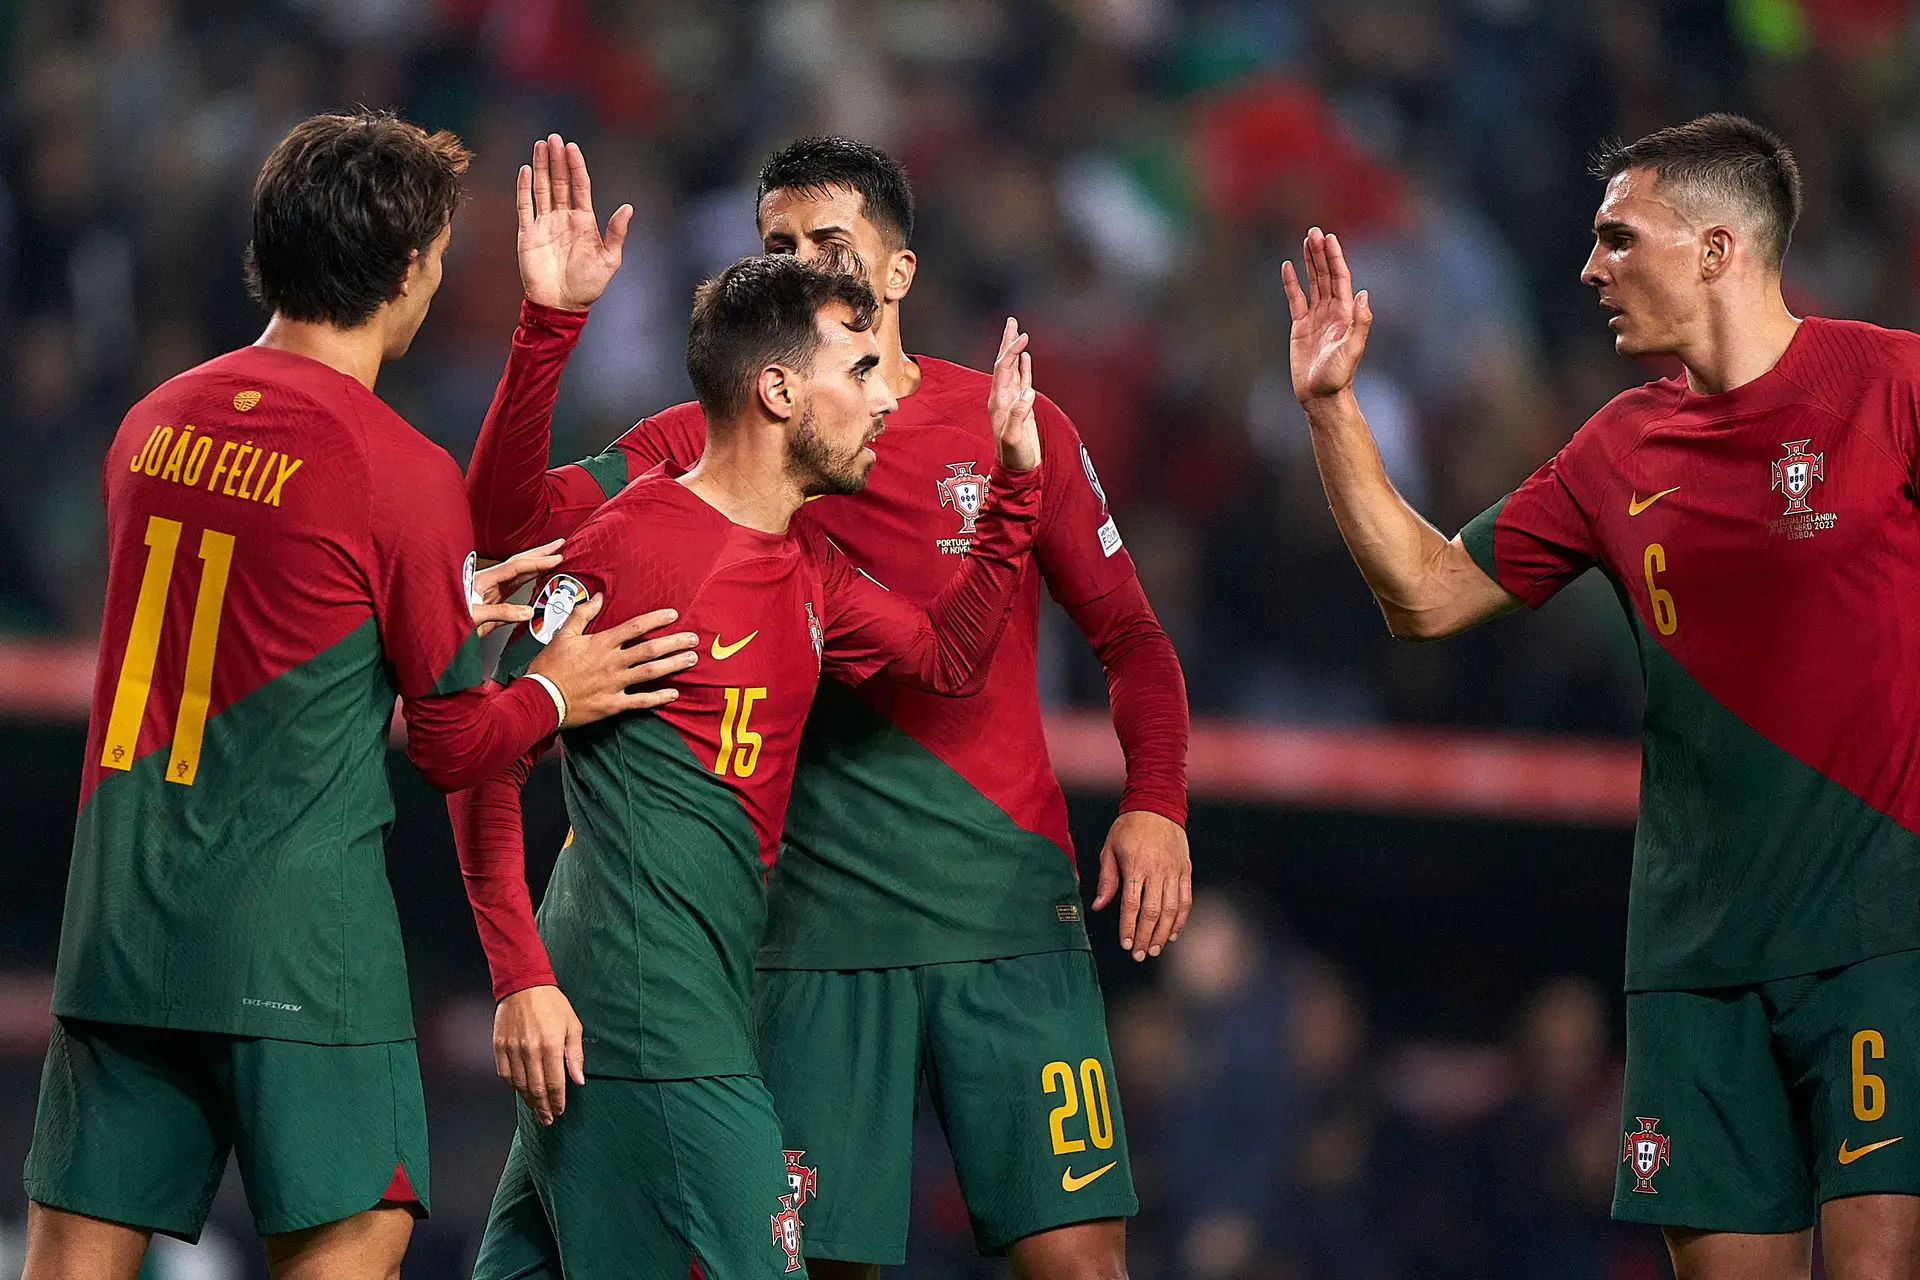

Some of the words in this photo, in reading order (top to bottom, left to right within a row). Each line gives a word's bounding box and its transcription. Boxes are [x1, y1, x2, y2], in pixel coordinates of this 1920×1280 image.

[130, 424, 214, 486] JOÃO
[207, 440, 304, 507] FÉLIX
[936, 538, 972, 547] PORTUGA
[941, 546, 949, 554] 19
[1787, 530, 1815, 540] LISBOA
[1814, 520, 1834, 530] 2023
[1643, 543, 1678, 635] 6
[100, 515, 236, 786] 11
[714, 687, 767, 777] 15
[1041, 1057, 1114, 1155] 20
[1851, 1029, 1886, 1121] 6
